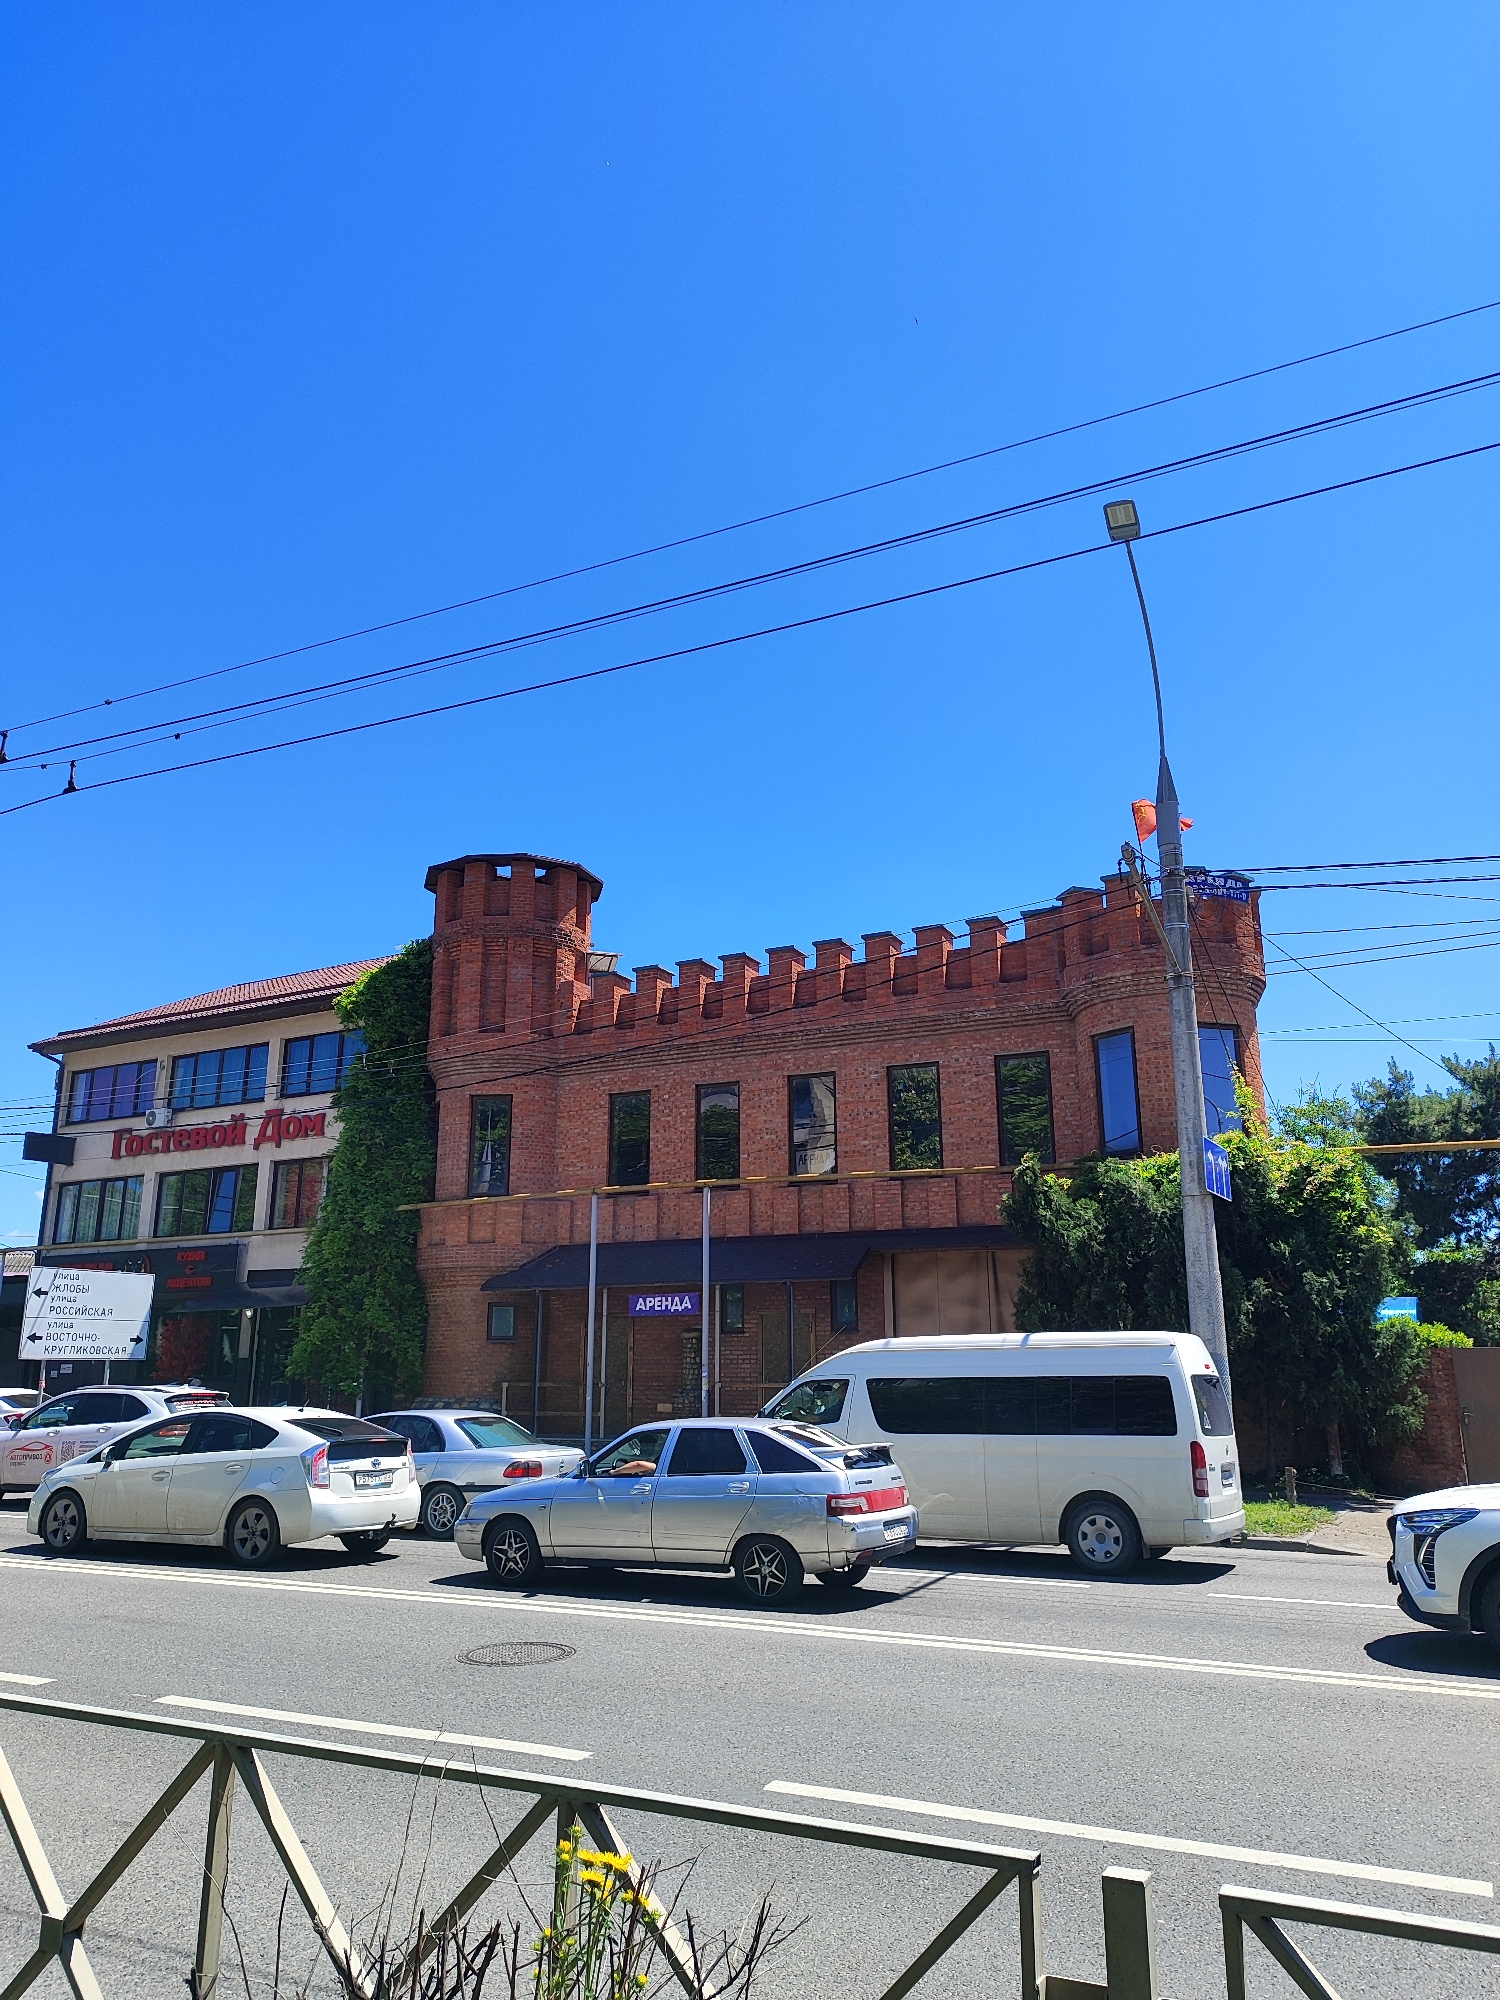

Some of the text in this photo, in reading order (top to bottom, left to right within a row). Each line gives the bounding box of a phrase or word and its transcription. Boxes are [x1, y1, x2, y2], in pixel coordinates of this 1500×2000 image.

[110, 1108, 327, 1159] Гостевой Дом
[176, 1251, 206, 1261] КУХНЯ
[53, 1272, 80, 1282] улица
[51, 1283, 90, 1294] ЖЛОБЫ
[50, 1295, 78, 1304] улица
[635, 1296, 692, 1313] АРЕНДА
[48, 1305, 114, 1317] РОССИЙСКАЯ
[46, 1321, 74, 1331] улица
[45, 1332, 101, 1342] ВОСТОЧНО-
[43, 1345, 128, 1356] КРУГЛИКОВСКАЯ
[9, 1453, 43, 1461] АВТОПРИВОЗ
